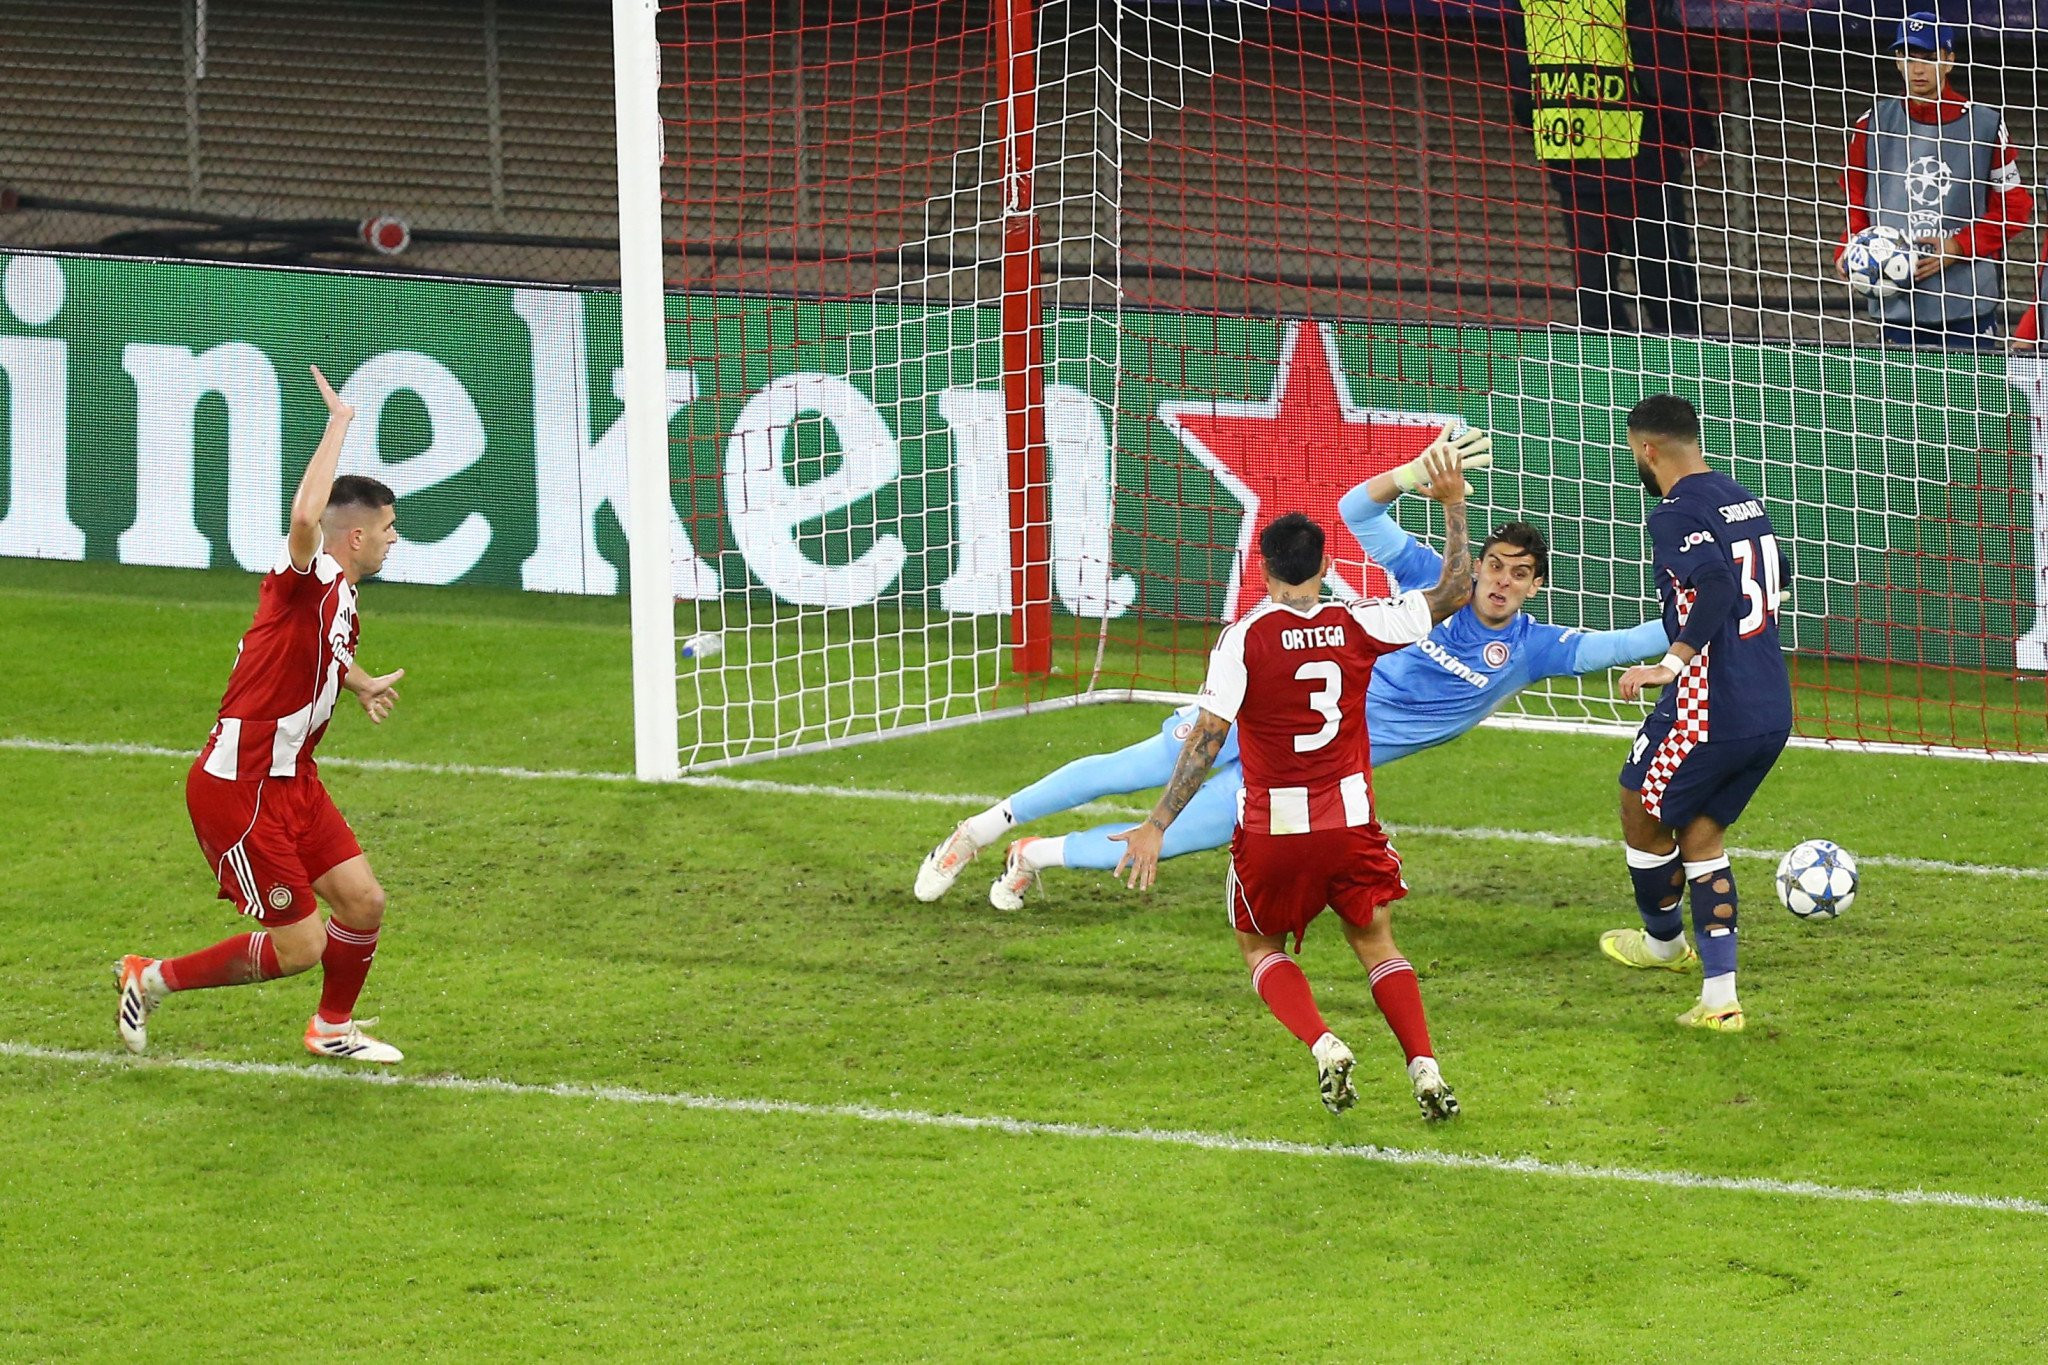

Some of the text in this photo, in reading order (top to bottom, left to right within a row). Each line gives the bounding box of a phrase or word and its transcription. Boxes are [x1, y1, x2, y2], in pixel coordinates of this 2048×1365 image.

[1731, 533, 1781, 636] 34
[1281, 625, 1346, 651] ORTEGA
[1415, 634, 1490, 689] toiximan
[1294, 660, 1344, 753] 3
[1626, 732, 1651, 766] 4
